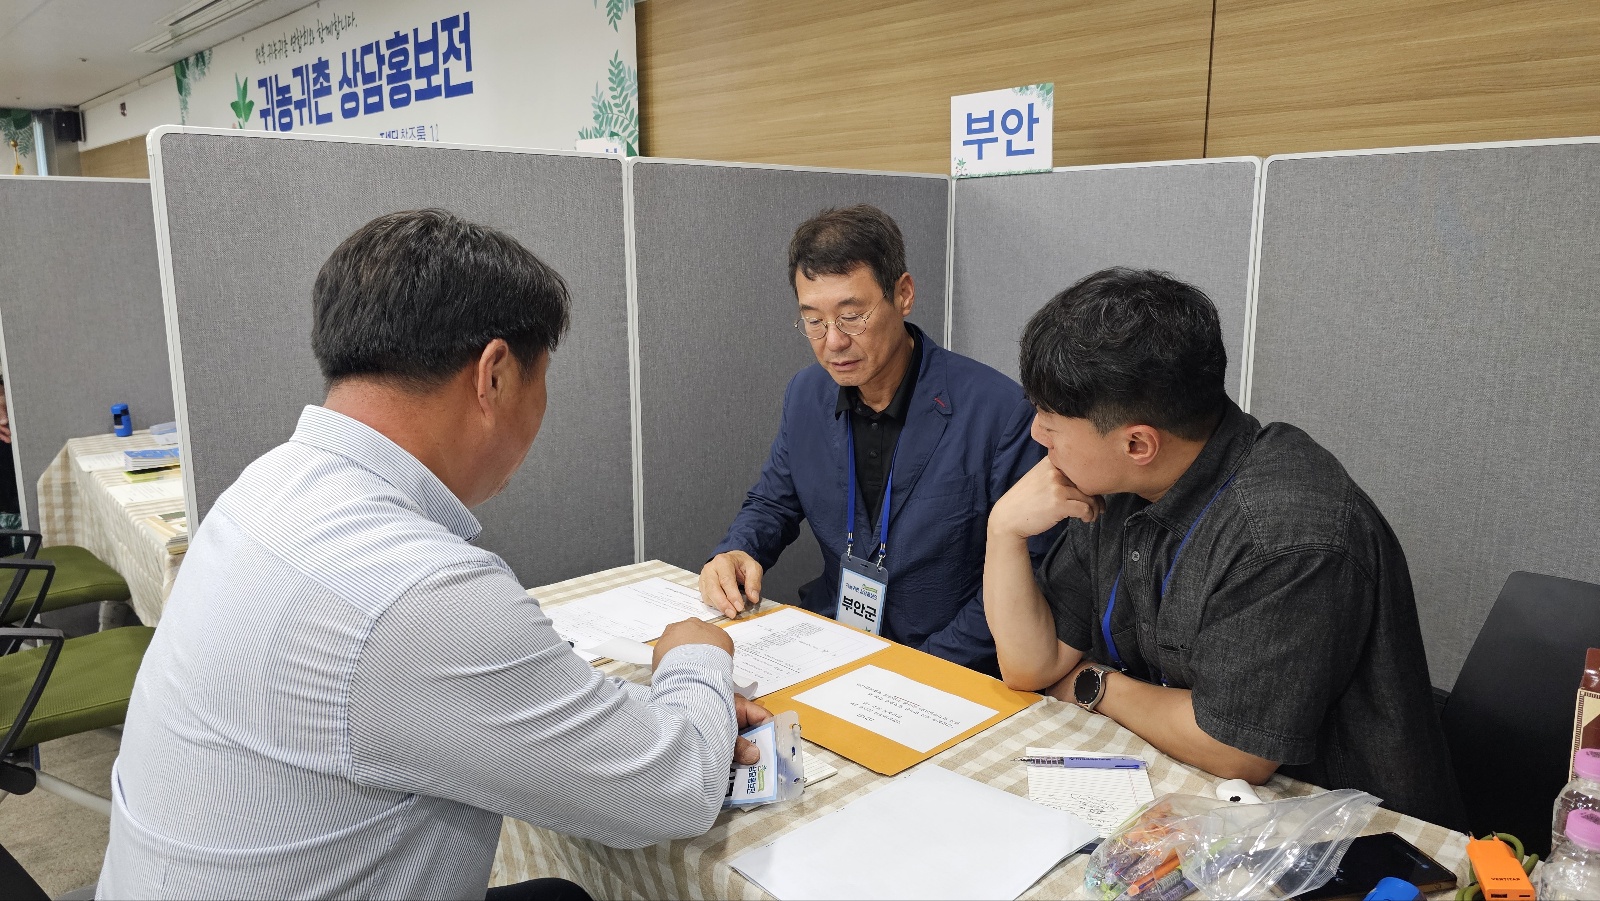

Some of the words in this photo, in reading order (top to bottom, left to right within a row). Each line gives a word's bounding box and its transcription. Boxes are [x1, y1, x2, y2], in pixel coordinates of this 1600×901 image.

[316, 11, 358, 44] 함께합니다.
[257, 57, 333, 132] 귀농귀촌
[338, 11, 474, 120] 상담홍보전
[962, 102, 1040, 160] 부안
[841, 595, 877, 623] 부안군
